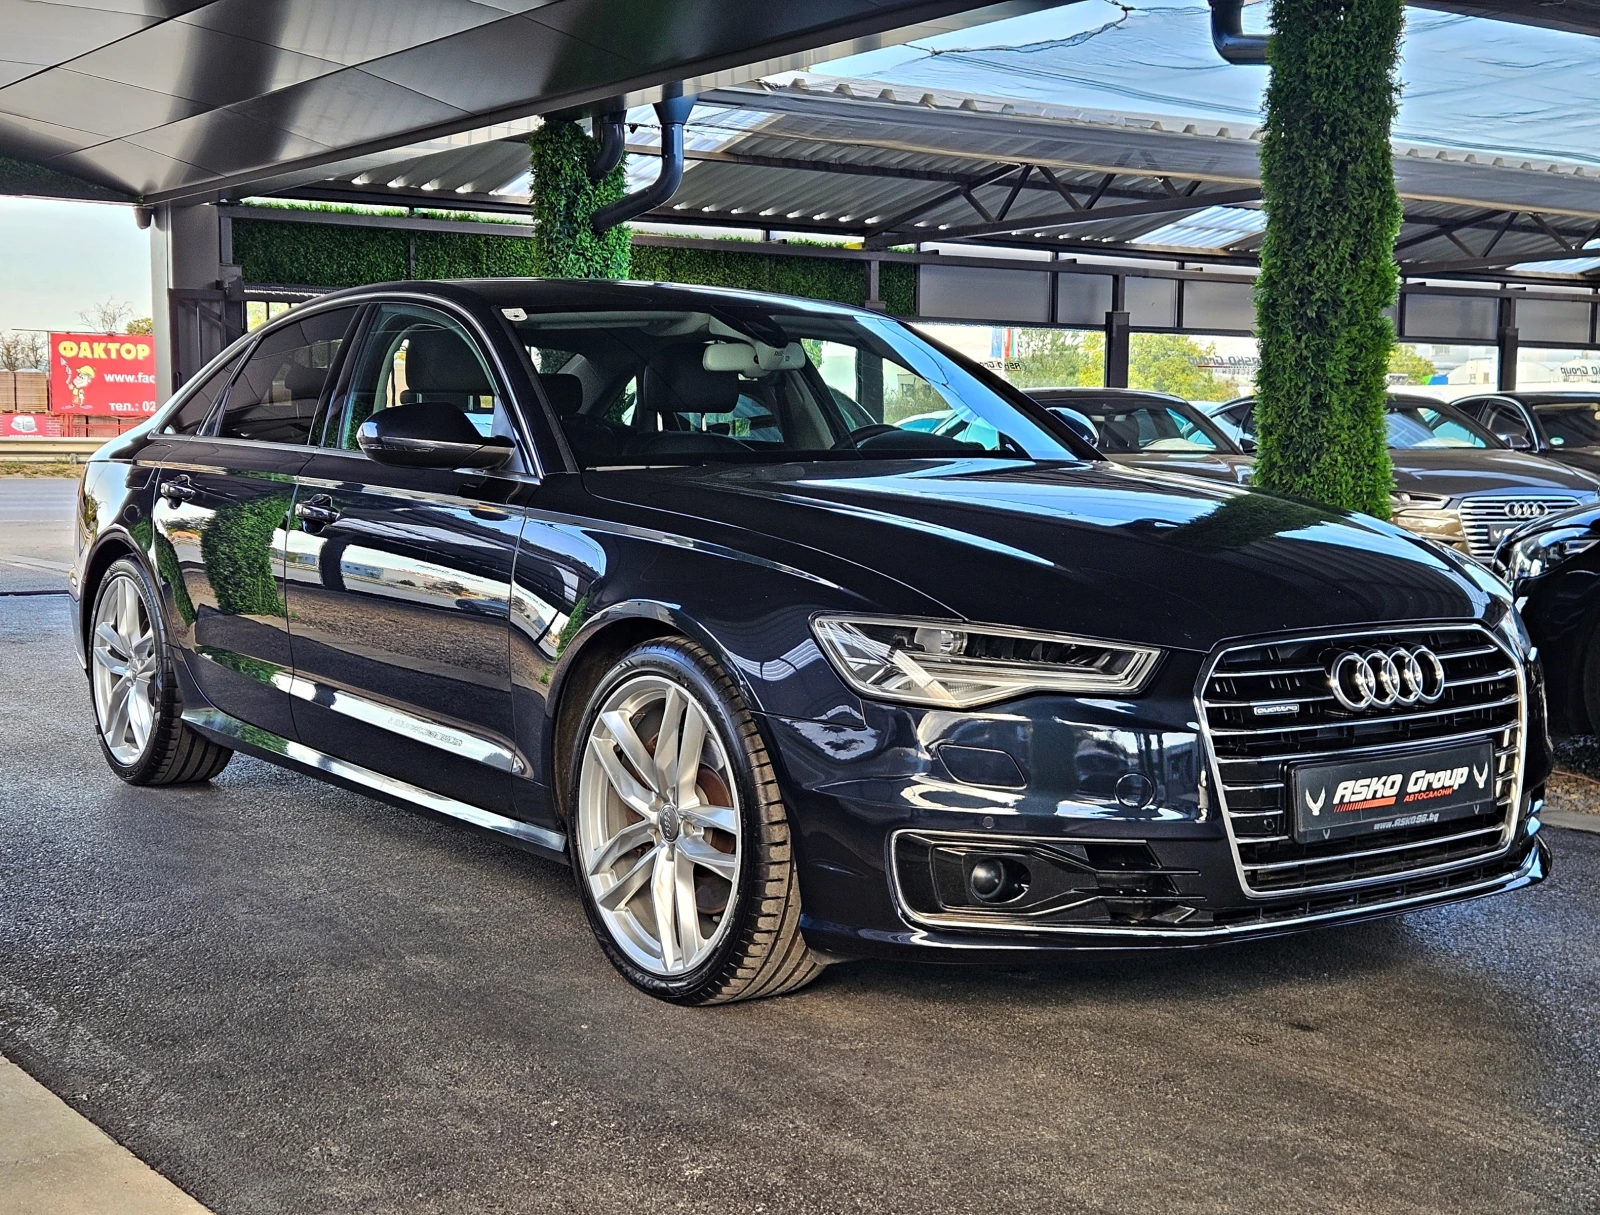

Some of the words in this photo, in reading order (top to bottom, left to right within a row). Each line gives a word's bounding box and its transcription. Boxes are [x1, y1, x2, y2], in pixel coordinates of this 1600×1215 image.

[58, 340, 151, 360] ФАКТОР
[109, 401, 139, 411] тел.:
[1257, 705, 1298, 714] quattro
[1332, 773, 1403, 804] ASKO
[1406, 766, 1469, 793] Group
[1403, 788, 1453, 803] АВТОСАЛОНИ
